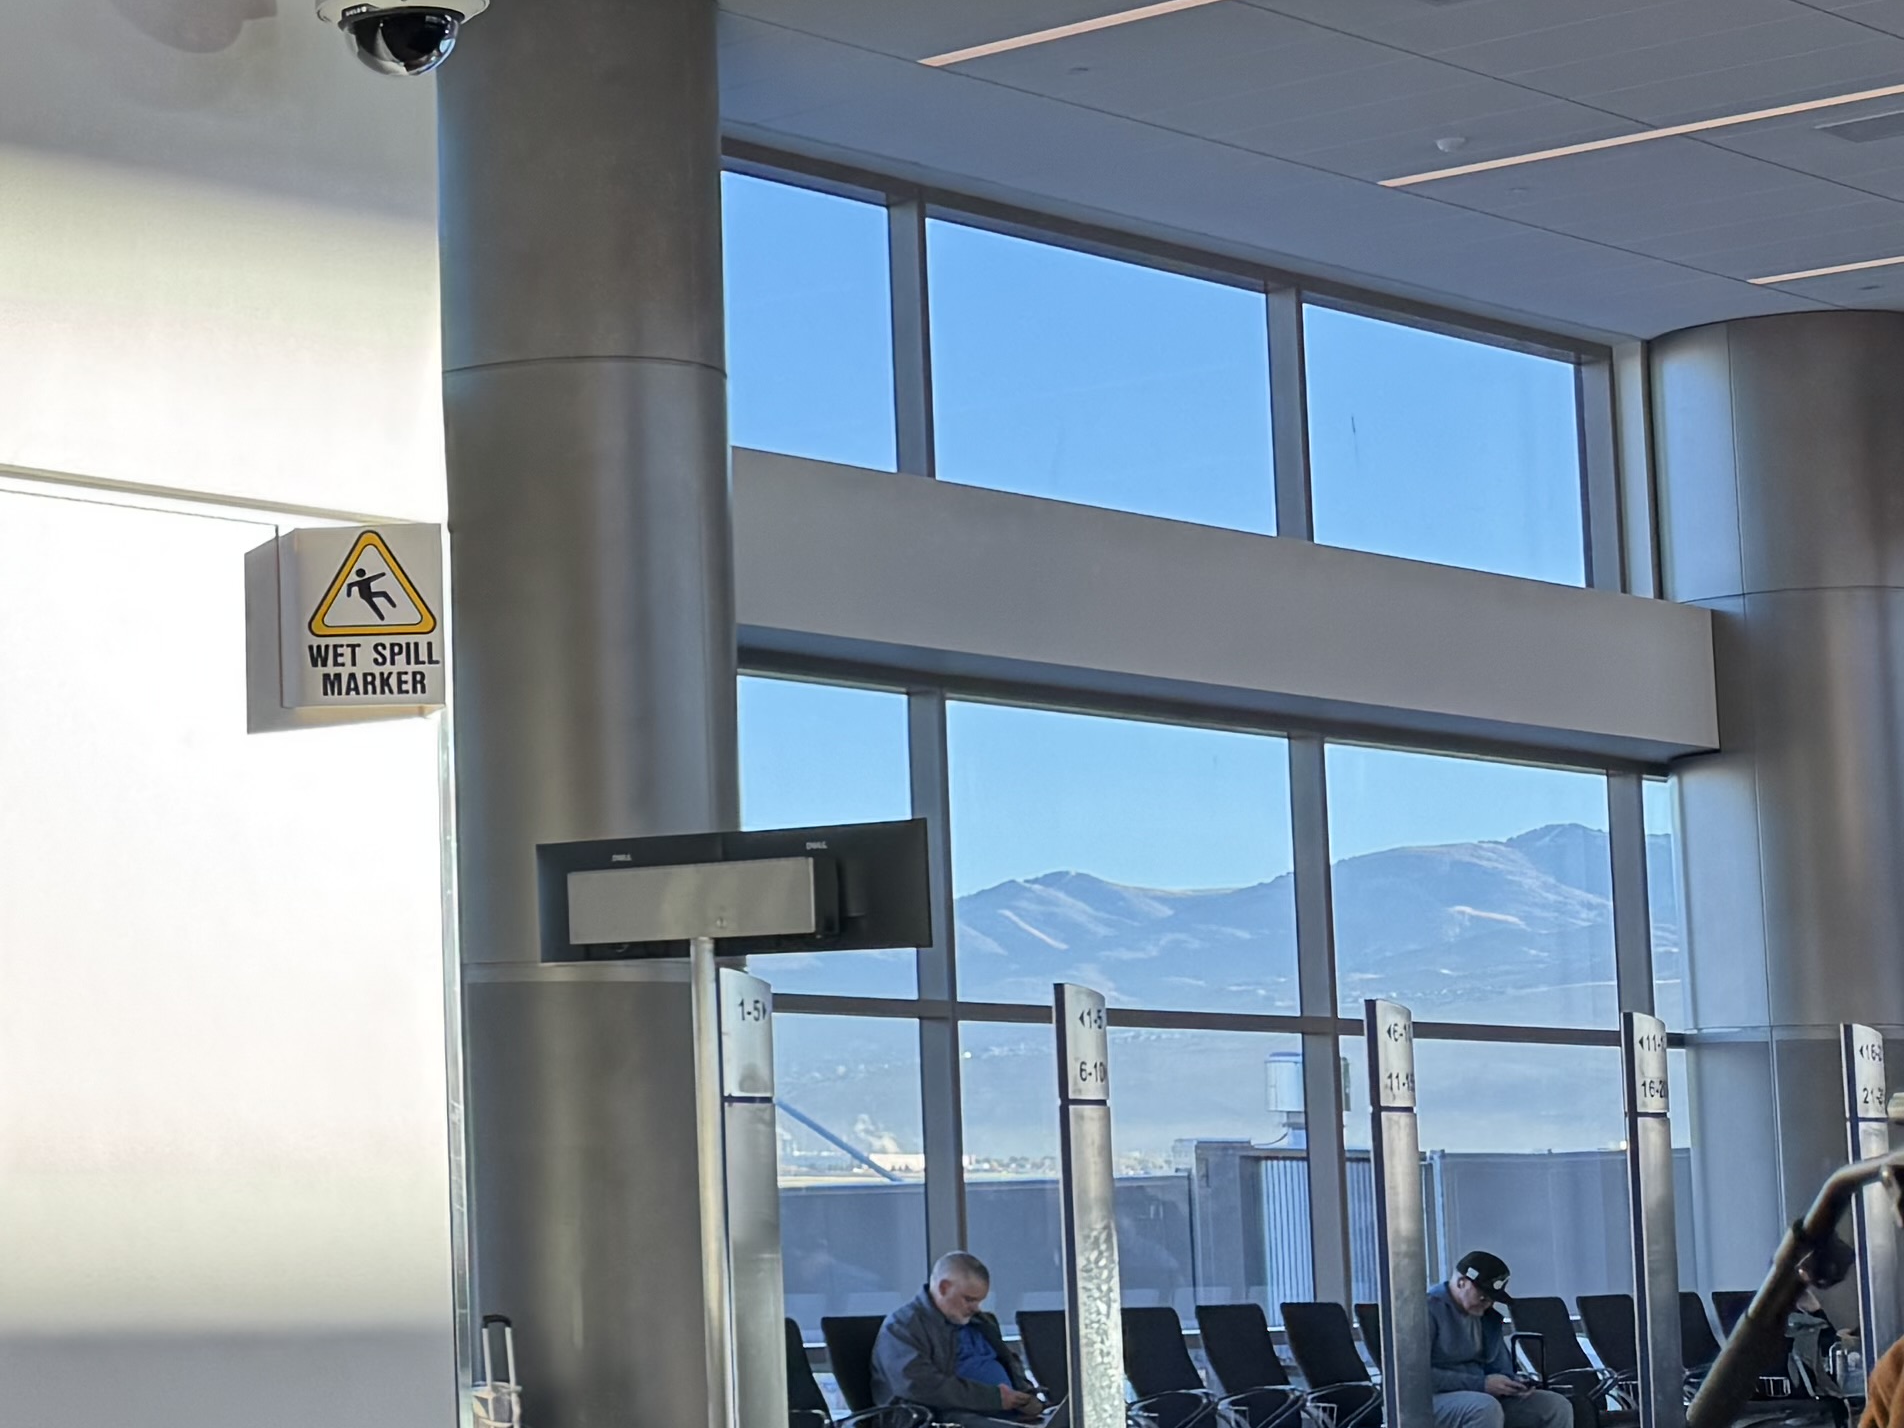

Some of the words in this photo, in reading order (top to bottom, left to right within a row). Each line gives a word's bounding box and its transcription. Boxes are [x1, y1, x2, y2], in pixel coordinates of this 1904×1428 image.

[308, 642, 362, 668] WET
[372, 640, 441, 667] SPILL
[321, 670, 427, 697] MARKER
[738, 998, 761, 1022] 1-5
[1086, 1008, 1103, 1030] 1-5
[1079, 1060, 1106, 1083] 6-10
